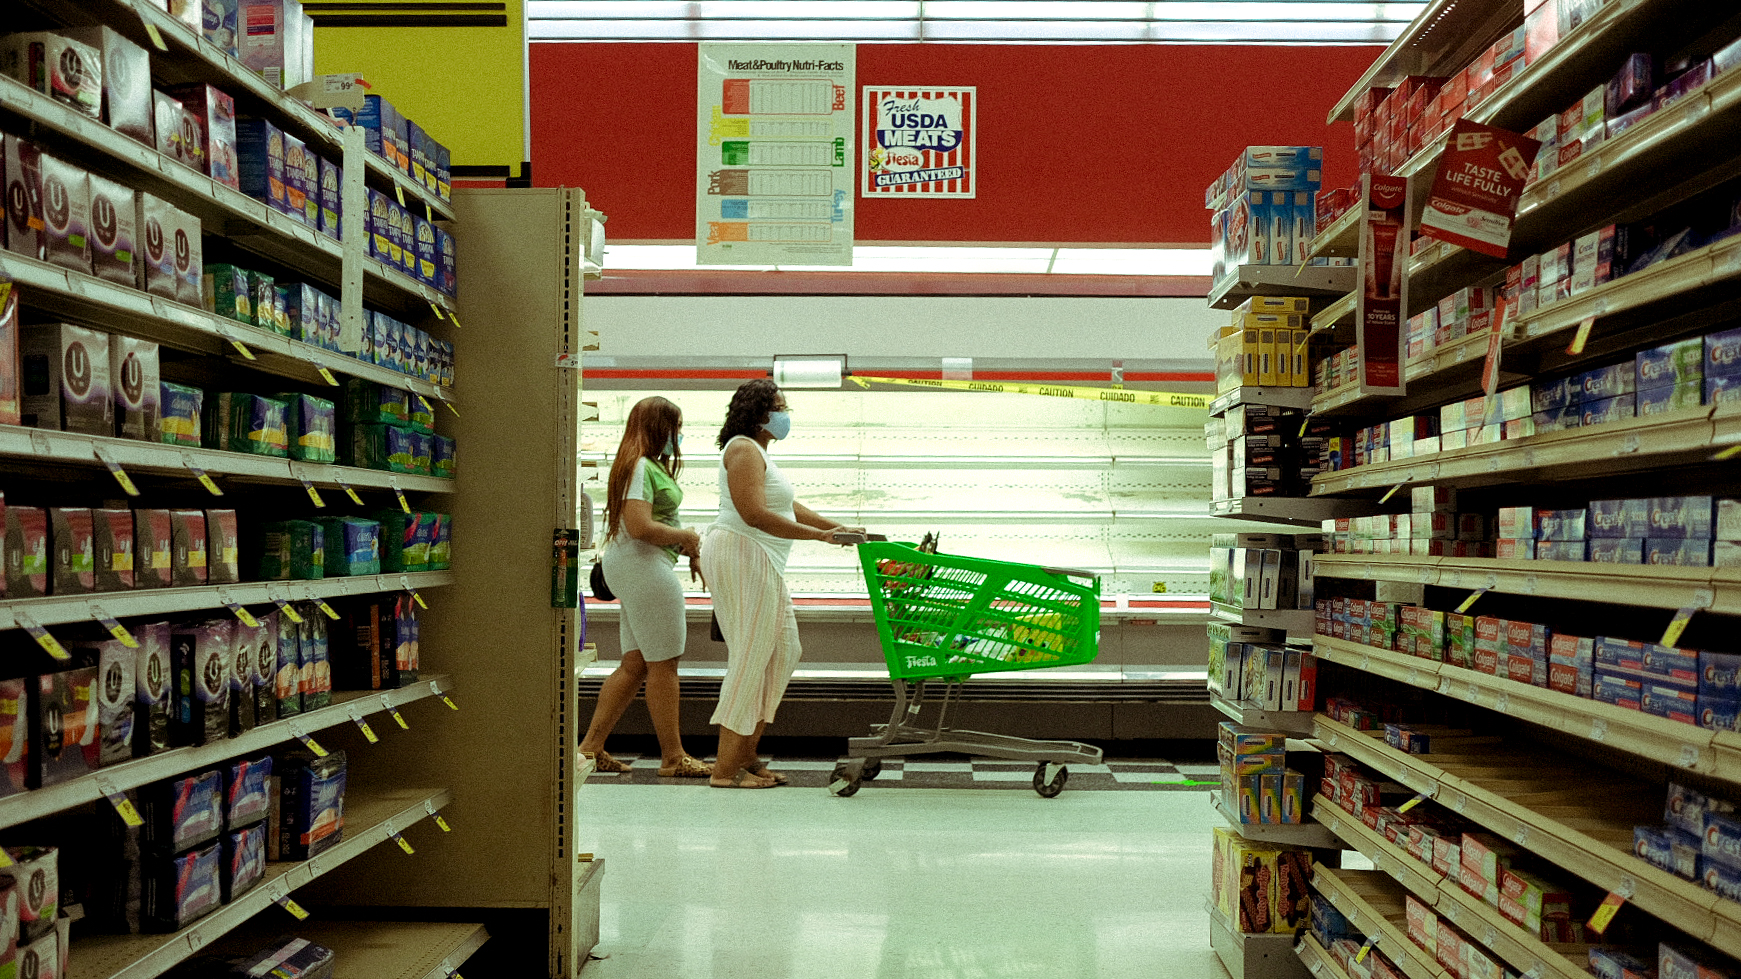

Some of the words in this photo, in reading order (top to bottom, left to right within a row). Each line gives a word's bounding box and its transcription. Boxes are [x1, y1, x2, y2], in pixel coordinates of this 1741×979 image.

[728, 59, 792, 72] Meat&Poultry
[793, 60, 844, 71] Nutri-Facts
[832, 85, 845, 111] Beef
[883, 99, 920, 116] Fresh
[891, 113, 948, 129] USDA
[184, 121, 191, 143] U
[884, 130, 956, 147] MEATS
[832, 137, 845, 167] Lamb
[876, 167, 962, 186] GUARANTEED
[1464, 162, 1502, 182] TASTE
[707, 171, 721, 195] Pork
[1373, 183, 1403, 193] Colgate
[1445, 170, 1473, 186] LIFE
[1473, 178, 1511, 197] FULLY
[13, 187, 23, 209] U
[50, 182, 63, 211] U
[831, 189, 846, 223] Turkey
[1431, 200, 1466, 213] Colgate
[98, 199, 110, 228] U
[150, 223, 160, 246] U
[177, 235, 186, 258] U
[1375, 313, 1396, 321] YEARS
[1471, 315, 1489, 329] Colgate
[72, 349, 84, 378] U
[128, 360, 139, 387] U
[969, 383, 1004, 393] CUIDADO
[1039, 386, 1074, 398] CAUTION
[1100, 391, 1136, 403] CUIDADO
[1170, 395, 1206, 407] CAUTION
[1594, 511, 1618, 529] Crest
[1651, 509, 1678, 529] Crest
[12, 550, 21, 566] U
[61, 549, 71, 565] U
[103, 549, 110, 563] U
[143, 547, 151, 561] U
[180, 546, 187, 561] U
[215, 543, 222, 556] U
[1592, 548, 1615, 562] Crest
[1651, 549, 1676, 564] Crest
[1351, 603, 1364, 614] Colgate
[1371, 604, 1385, 615] Colgate
[1476, 620, 1497, 636] Colgate
[1509, 624, 1530, 641] Colgate
[1552, 636, 1575, 652] Colgate
[904, 655, 938, 669] Fiesta
[1474, 651, 1495, 668] Colgate
[1509, 659, 1530, 676] Colgate
[1643, 653, 1666, 667] Crest
[111, 670, 119, 690] U
[150, 660, 159, 683] U
[1550, 668, 1575, 687] Colgate
[1704, 665, 1734, 688] Crest
[49, 709, 58, 734] U
[1702, 708, 1734, 731] Crest
[1463, 839, 1483, 862] Colgate
[1706, 824, 1741, 858] Cres
[32, 875, 43, 902] U
[1460, 866, 1485, 893] Colgate
[1503, 872, 1523, 894] Colgate
[1256, 898, 1269, 925] Nutty
[1406, 899, 1425, 922] Colgate
[1500, 896, 1526, 919] Colgate
[1437, 925, 1456, 949] Colgate
[24, 954, 36, 979] U
